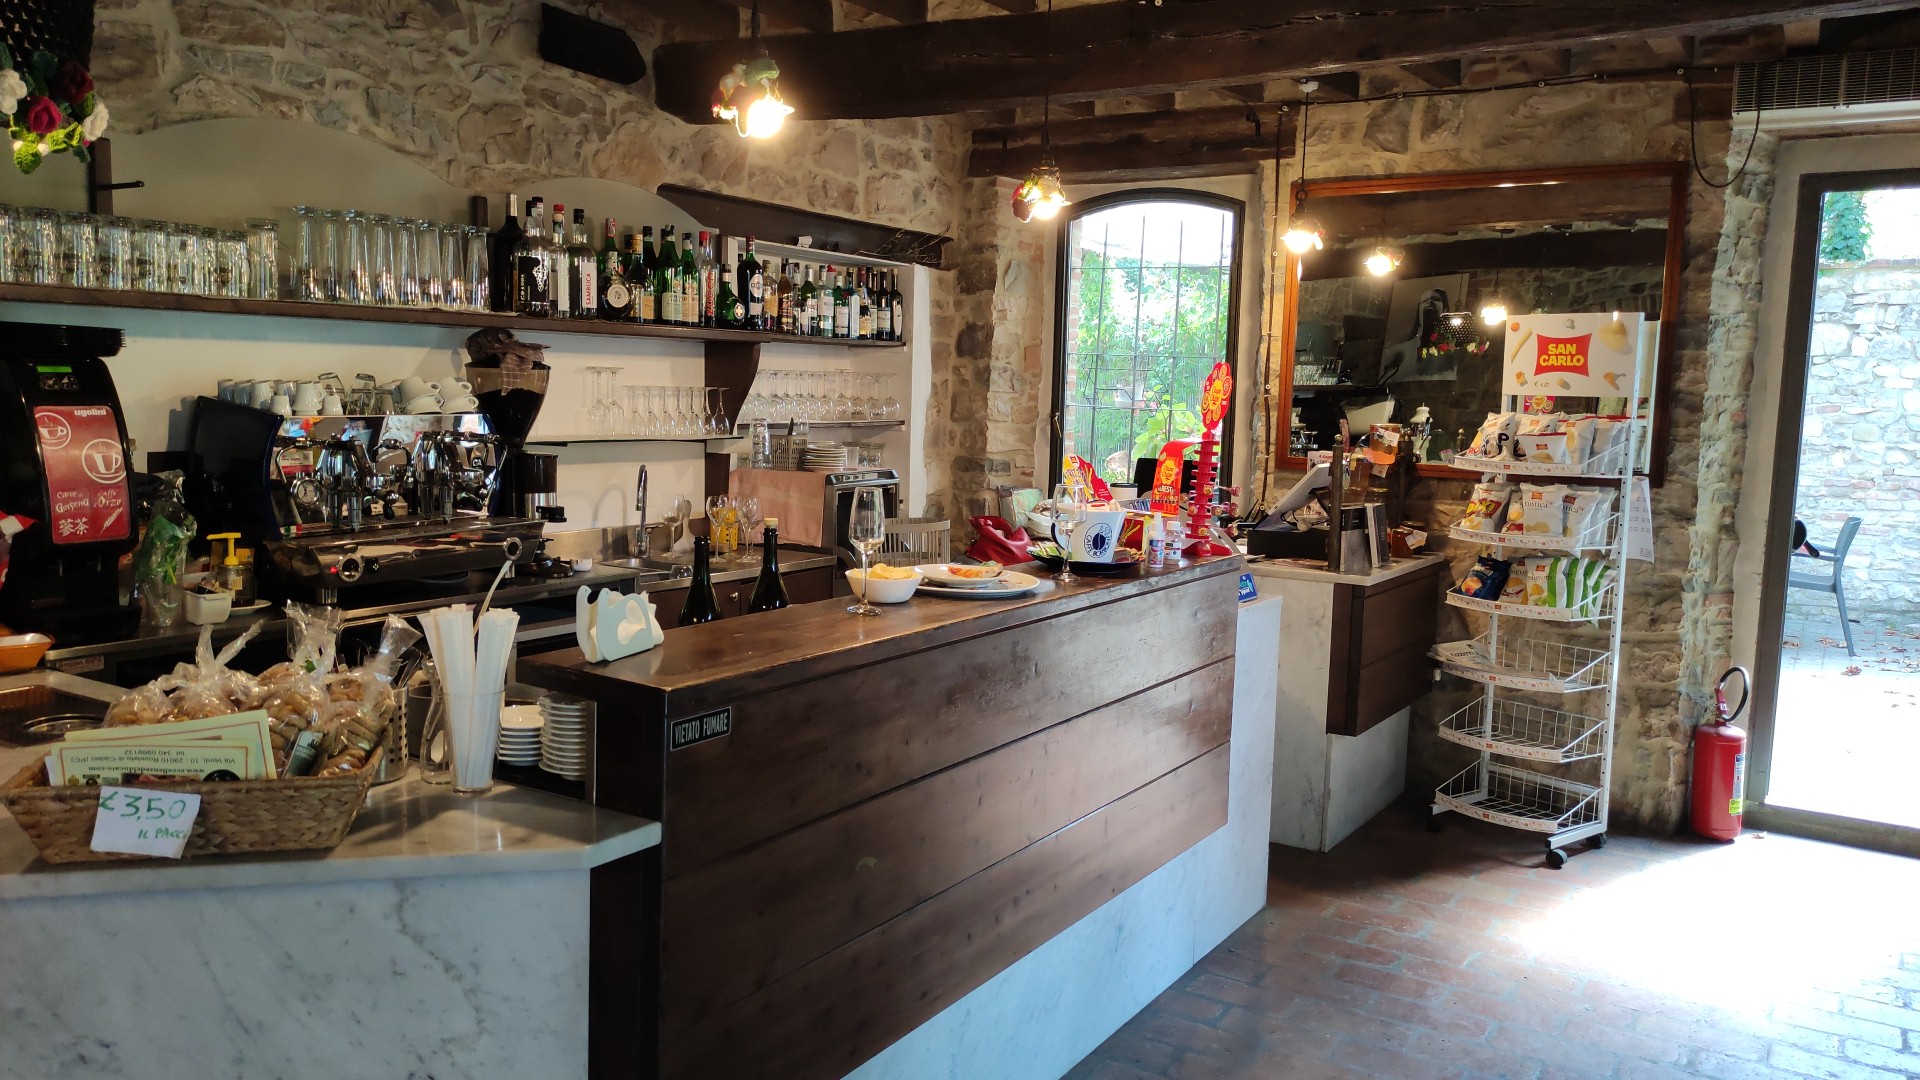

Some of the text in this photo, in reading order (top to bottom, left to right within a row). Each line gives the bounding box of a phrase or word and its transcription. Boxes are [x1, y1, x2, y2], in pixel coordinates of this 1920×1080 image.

[1548, 343, 1577, 355] SAN
[1539, 354, 1585, 367] CARLO
[74, 408, 107, 418] ugolini
[674, 712, 728, 745] VIETATO FUMARE
[138, 829, 148, 839] IL
